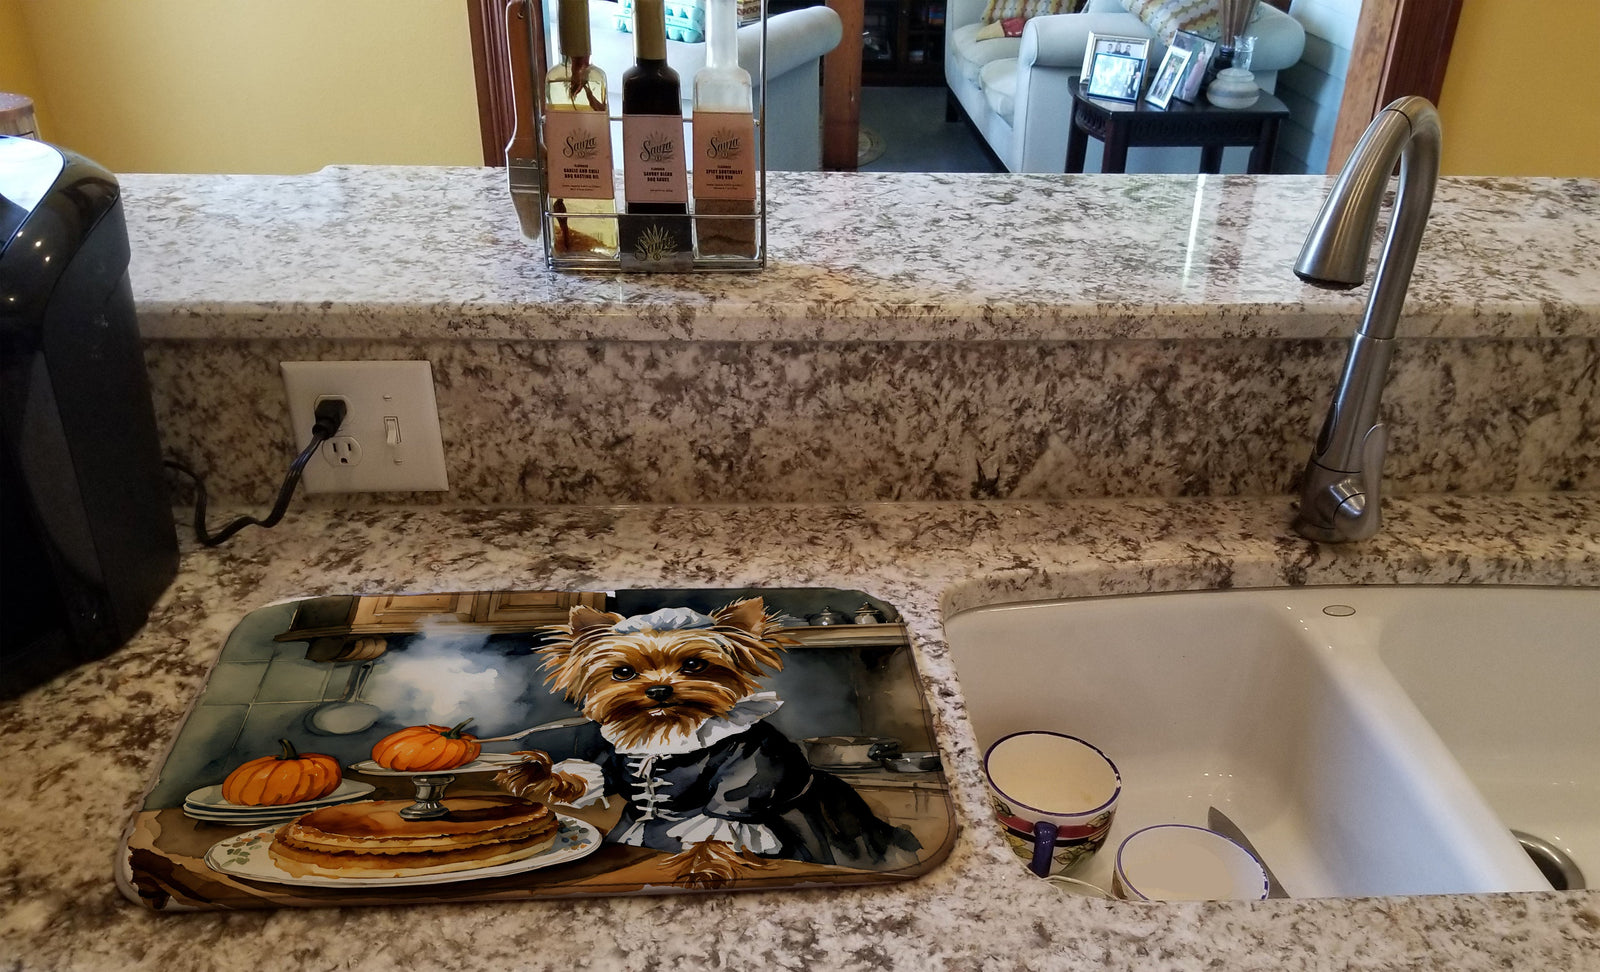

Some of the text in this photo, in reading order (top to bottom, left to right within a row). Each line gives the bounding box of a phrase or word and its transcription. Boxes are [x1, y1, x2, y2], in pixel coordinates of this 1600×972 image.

[563, 136, 597, 158] Sauza
[640, 140, 673, 162] Sauza
[706, 136, 740, 159] Sauza
